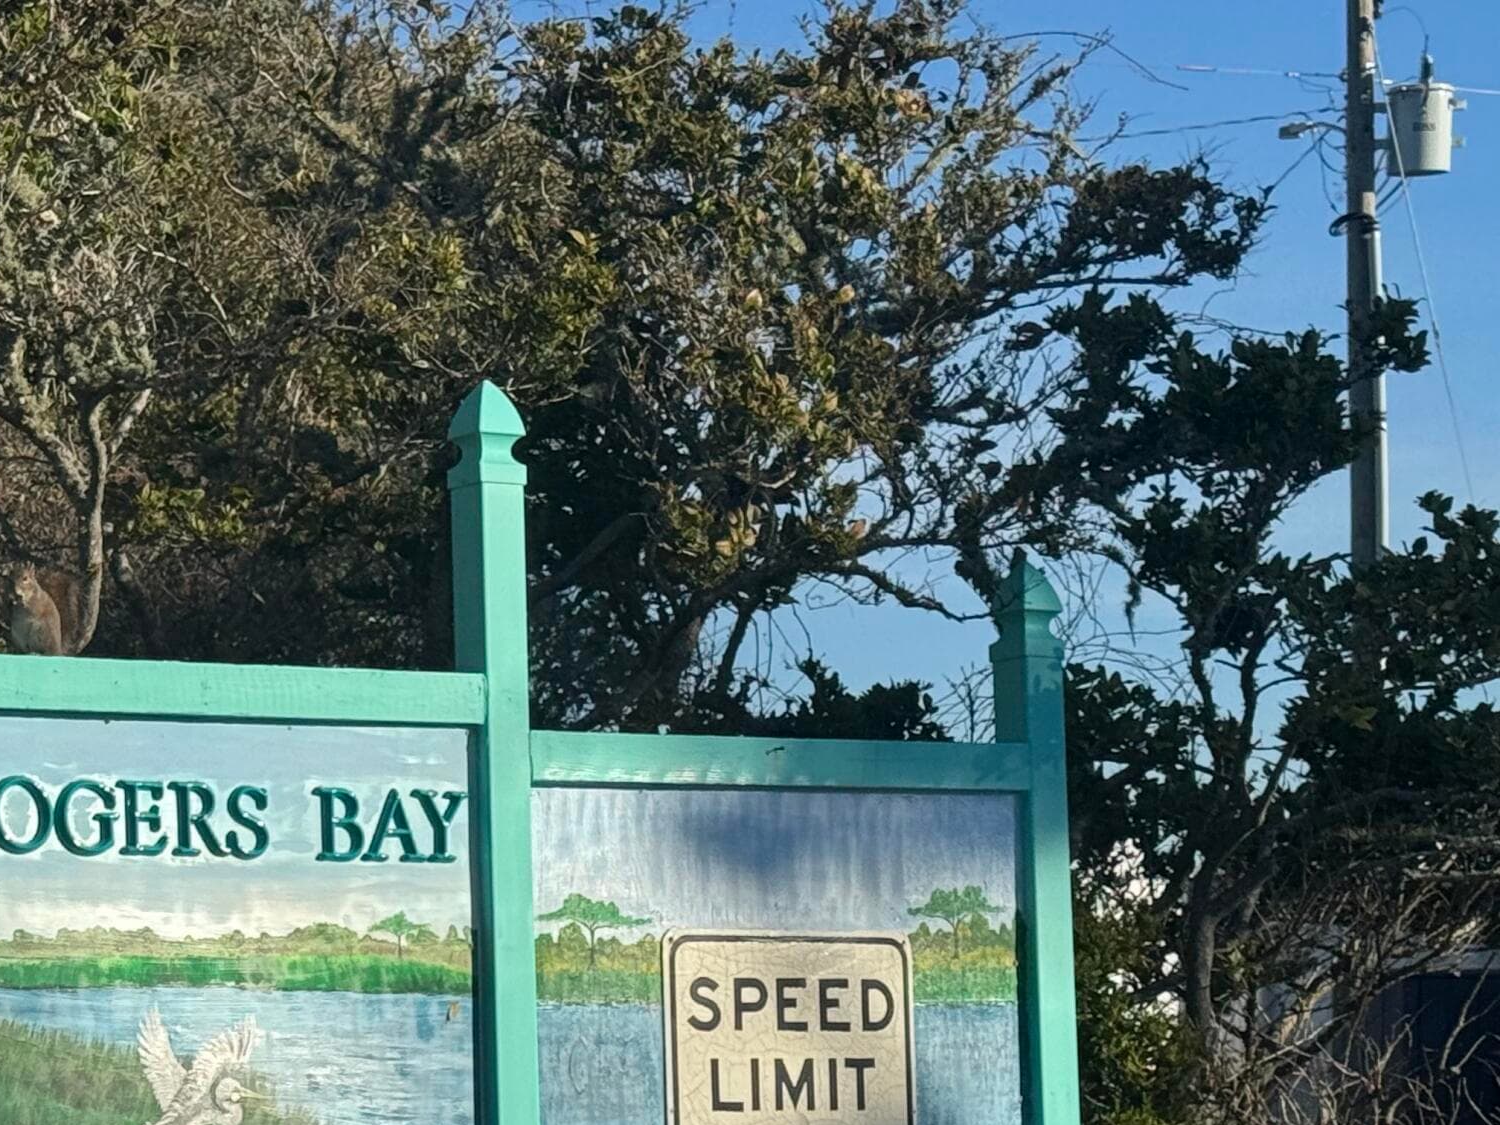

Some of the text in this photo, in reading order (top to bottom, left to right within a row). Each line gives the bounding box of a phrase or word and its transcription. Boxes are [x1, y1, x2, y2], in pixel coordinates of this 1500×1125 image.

[310, 785, 469, 863] BAY
[687, 976, 895, 1032] SPEED
[710, 1058, 875, 1112] LIMIT
